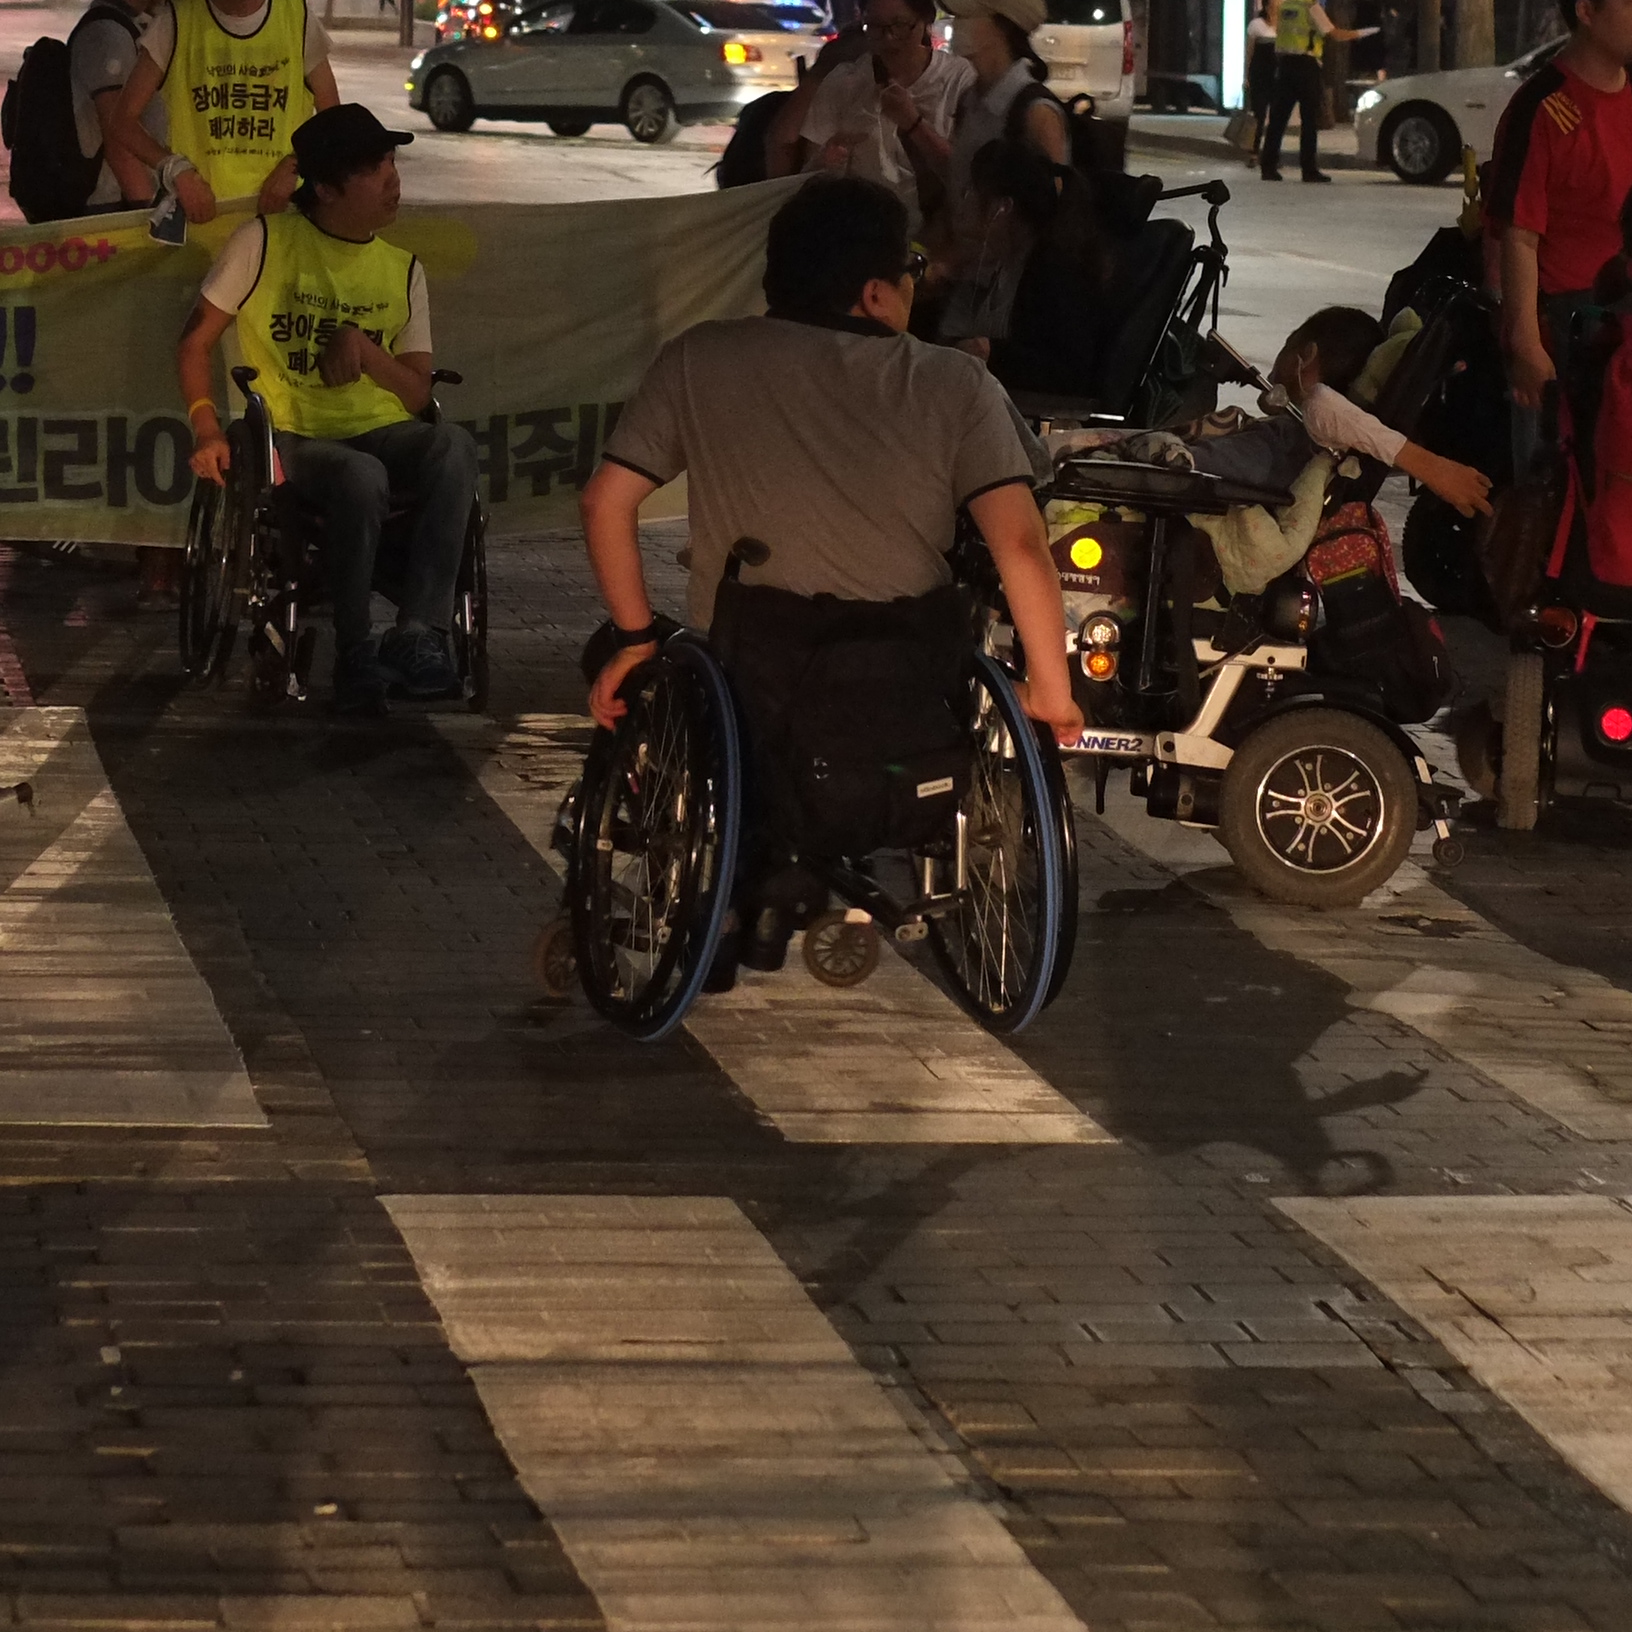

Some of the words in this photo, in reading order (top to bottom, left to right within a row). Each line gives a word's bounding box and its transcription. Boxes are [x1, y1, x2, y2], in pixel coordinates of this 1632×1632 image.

[191, 83, 290, 113] 장애등급제
[208, 115, 276, 141] 폐지하라
[1058, 734, 1144, 753] NNER2
